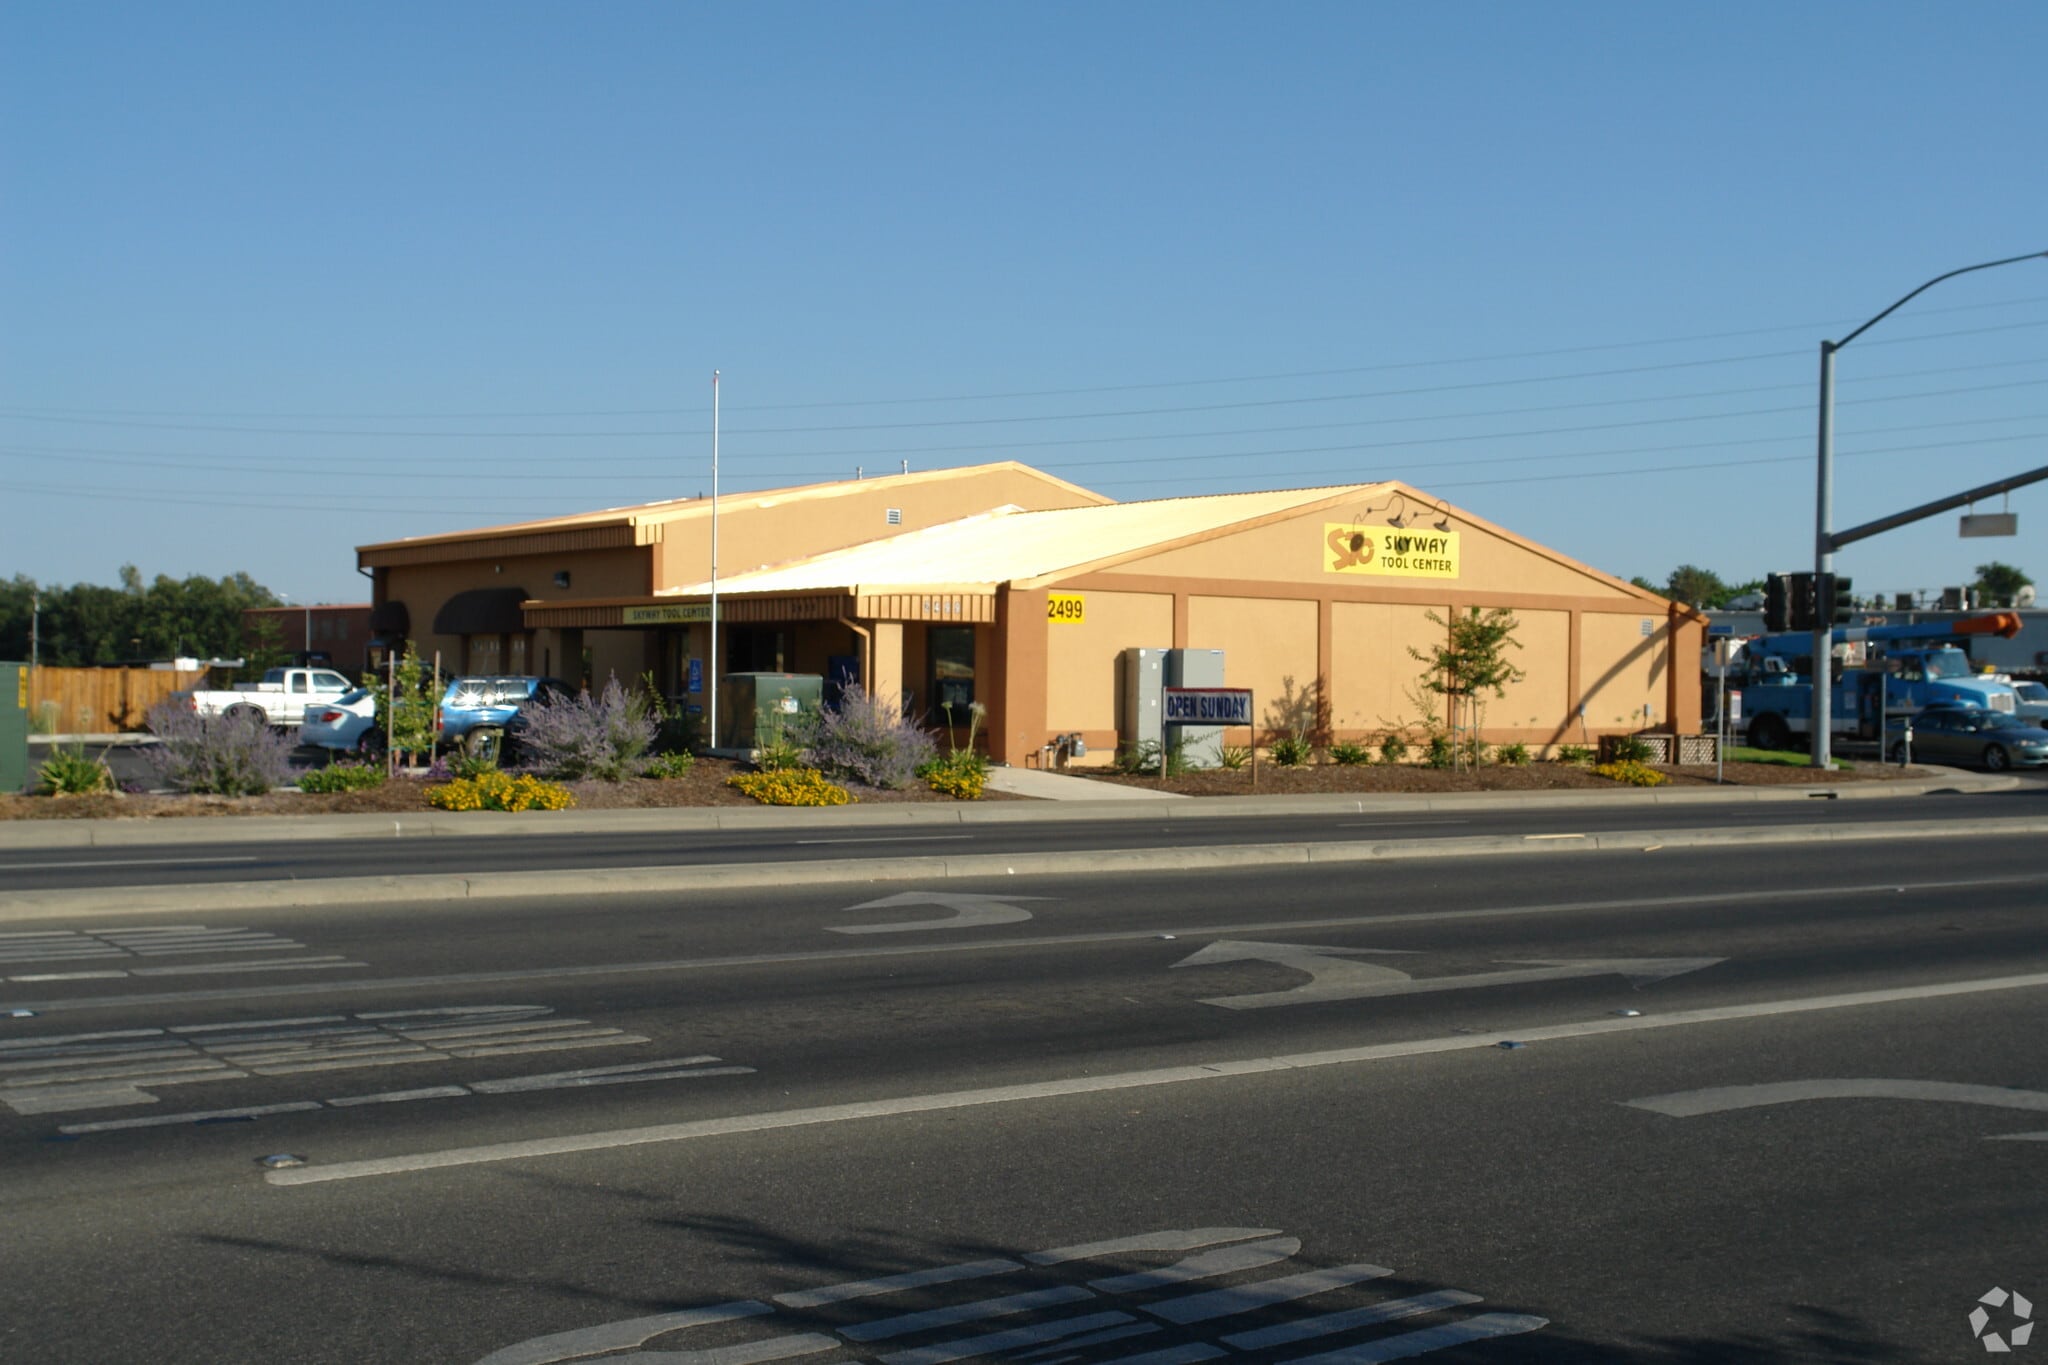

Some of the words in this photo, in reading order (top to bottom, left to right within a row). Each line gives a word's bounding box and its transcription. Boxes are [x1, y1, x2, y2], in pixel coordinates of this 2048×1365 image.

[1385, 535, 1448, 554] SKYWAY
[1381, 556, 1409, 569] TOOL
[1412, 558, 1452, 572] CENTER
[633, 609, 660, 620] SKYWAY
[662, 608, 681, 619] TOOL
[683, 607, 711, 618] CENTER
[1047, 600, 1083, 619] 2499
[1167, 695, 1197, 717] OPEN
[1200, 696, 1246, 718] SUNDAY
